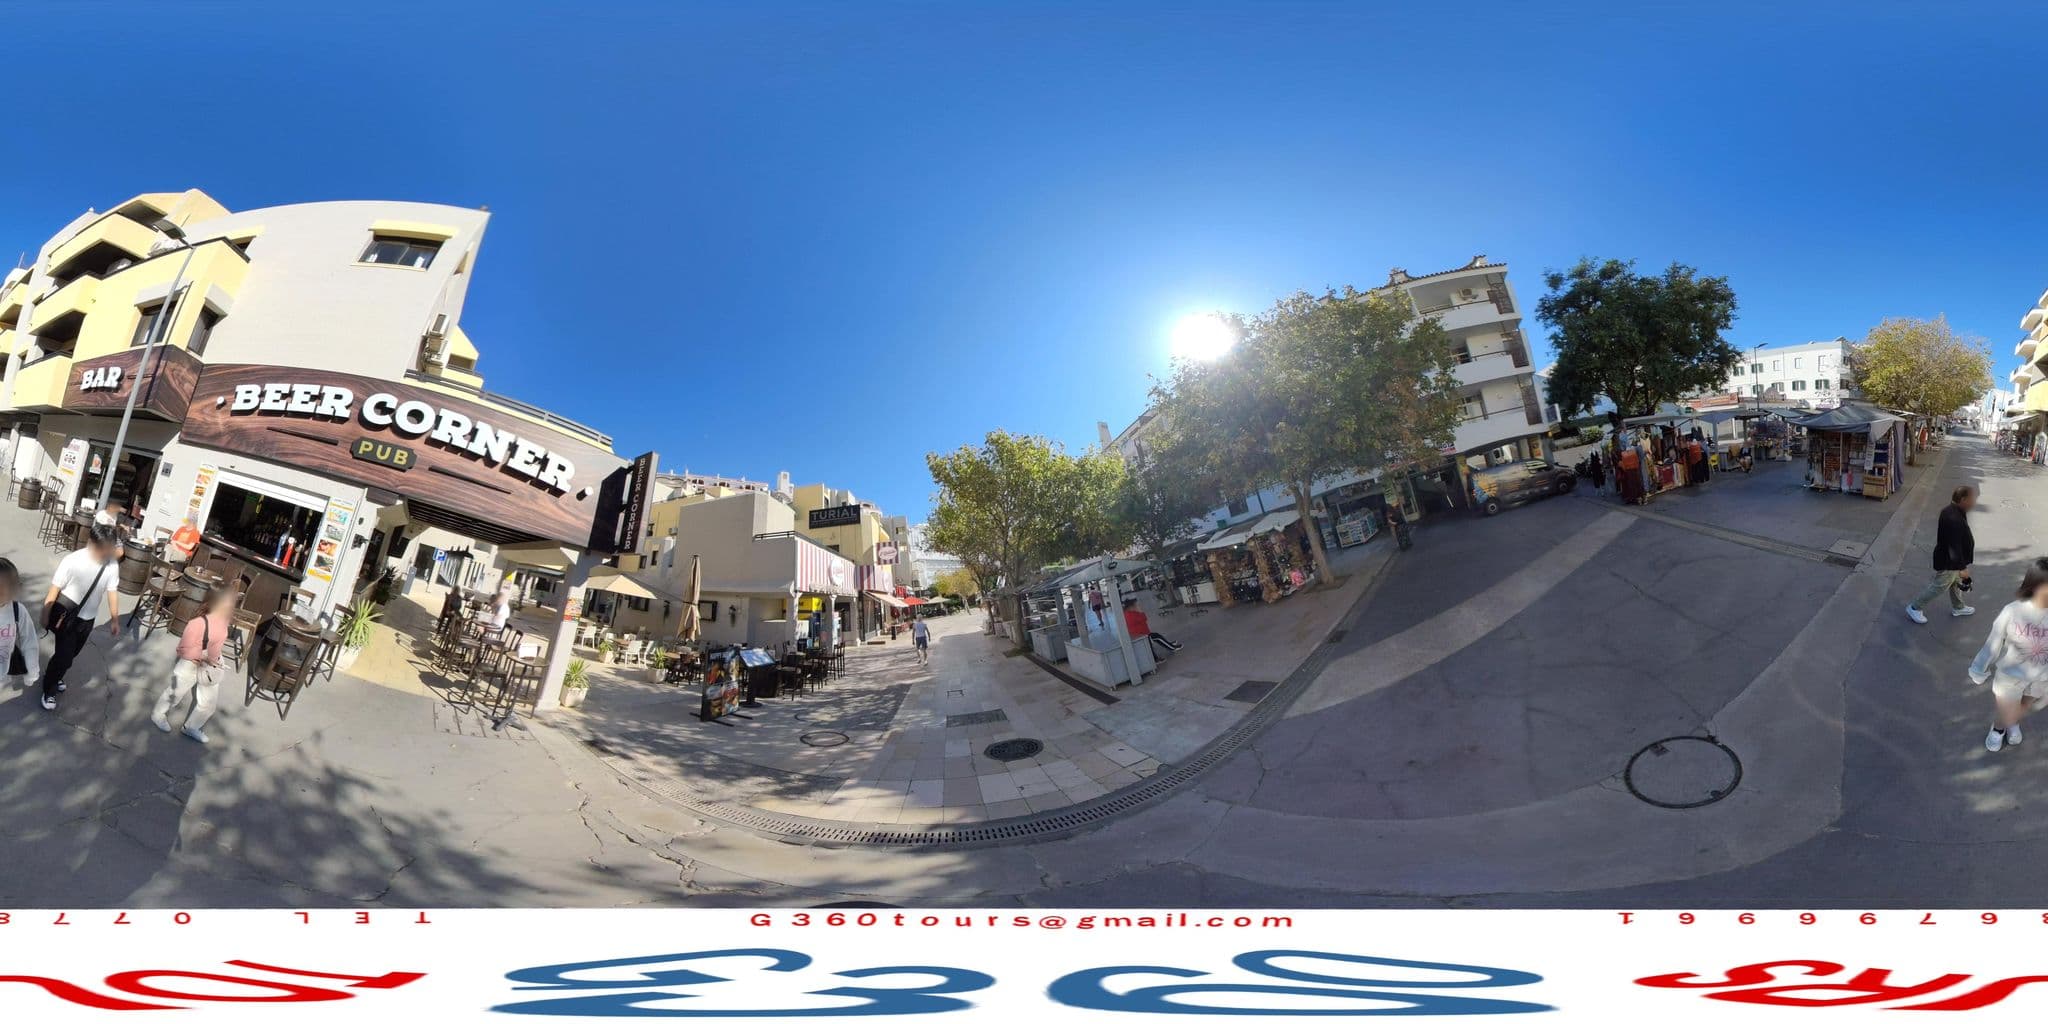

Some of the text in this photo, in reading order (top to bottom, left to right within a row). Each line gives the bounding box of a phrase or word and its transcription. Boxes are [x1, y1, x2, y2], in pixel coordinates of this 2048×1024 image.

[79, 366, 122, 390] BAR
[231, 383, 576, 493] BEER CORNER
[358, 440, 409, 466] PUB
[624, 457, 646, 550] BEER CORNER
